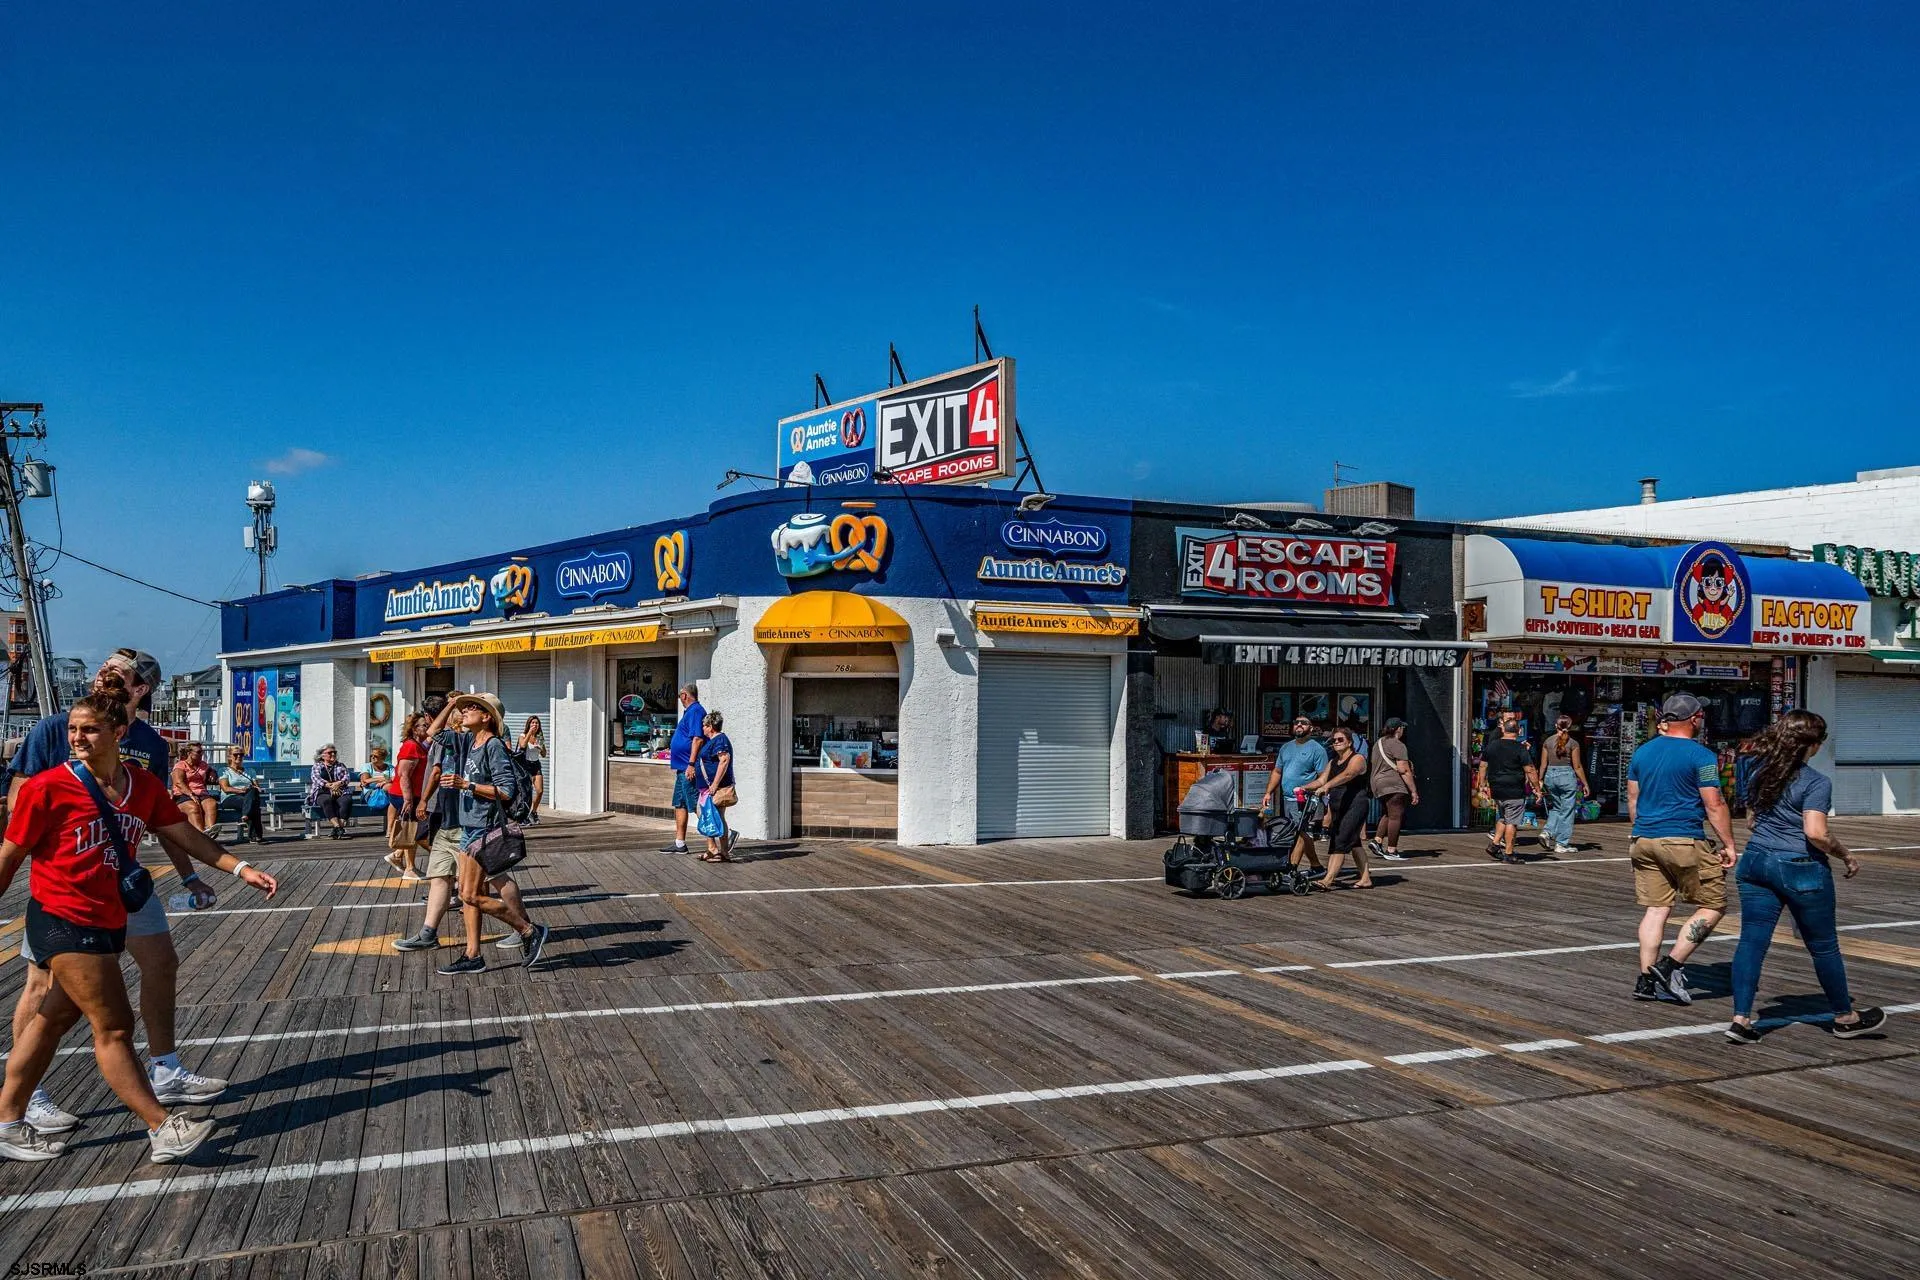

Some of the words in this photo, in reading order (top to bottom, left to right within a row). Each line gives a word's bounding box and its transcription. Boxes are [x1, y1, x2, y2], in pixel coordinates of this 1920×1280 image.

[806, 420, 837, 437] Auntie
[882, 393, 967, 470] EXIT
[971, 387, 997, 442] 4
[806, 433, 837, 451] Anne's
[821, 466, 866, 486] CINNABON
[938, 455, 994, 476] ROOMS
[1008, 525, 1099, 547] CINNABON
[1237, 537, 1387, 569] ESCAPE
[560, 559, 626, 590] CINNABON
[1186, 542, 1205, 587] EXIT
[1207, 543, 1236, 588] 4
[1236, 566, 1383, 597] ROOMS
[1541, 585, 1652, 621] T-SHIRT
[1076, 618, 1134, 631] CINNABON
[1761, 598, 1859, 631] FACTORY
[602, 628, 646, 643] CINNABON
[829, 628, 885, 639] CINNABON
[1525, 618, 1550, 633] GIFTS
[1556, 620, 1604, 637] SOUVENIRS
[1610, 623, 1637, 638] BEACH
[1638, 625, 1661, 640] GEAR
[490, 640, 523, 652] CINNABON
[1845, 634, 1867, 648] KIDS
[1234, 644, 1281, 664] EXIT
[1285, 646, 1300, 665] 4
[1305, 645, 1383, 666] ESCAPE
[1384, 647, 1458, 667] ROOMS
[129, 749, 151, 760] BEACH
